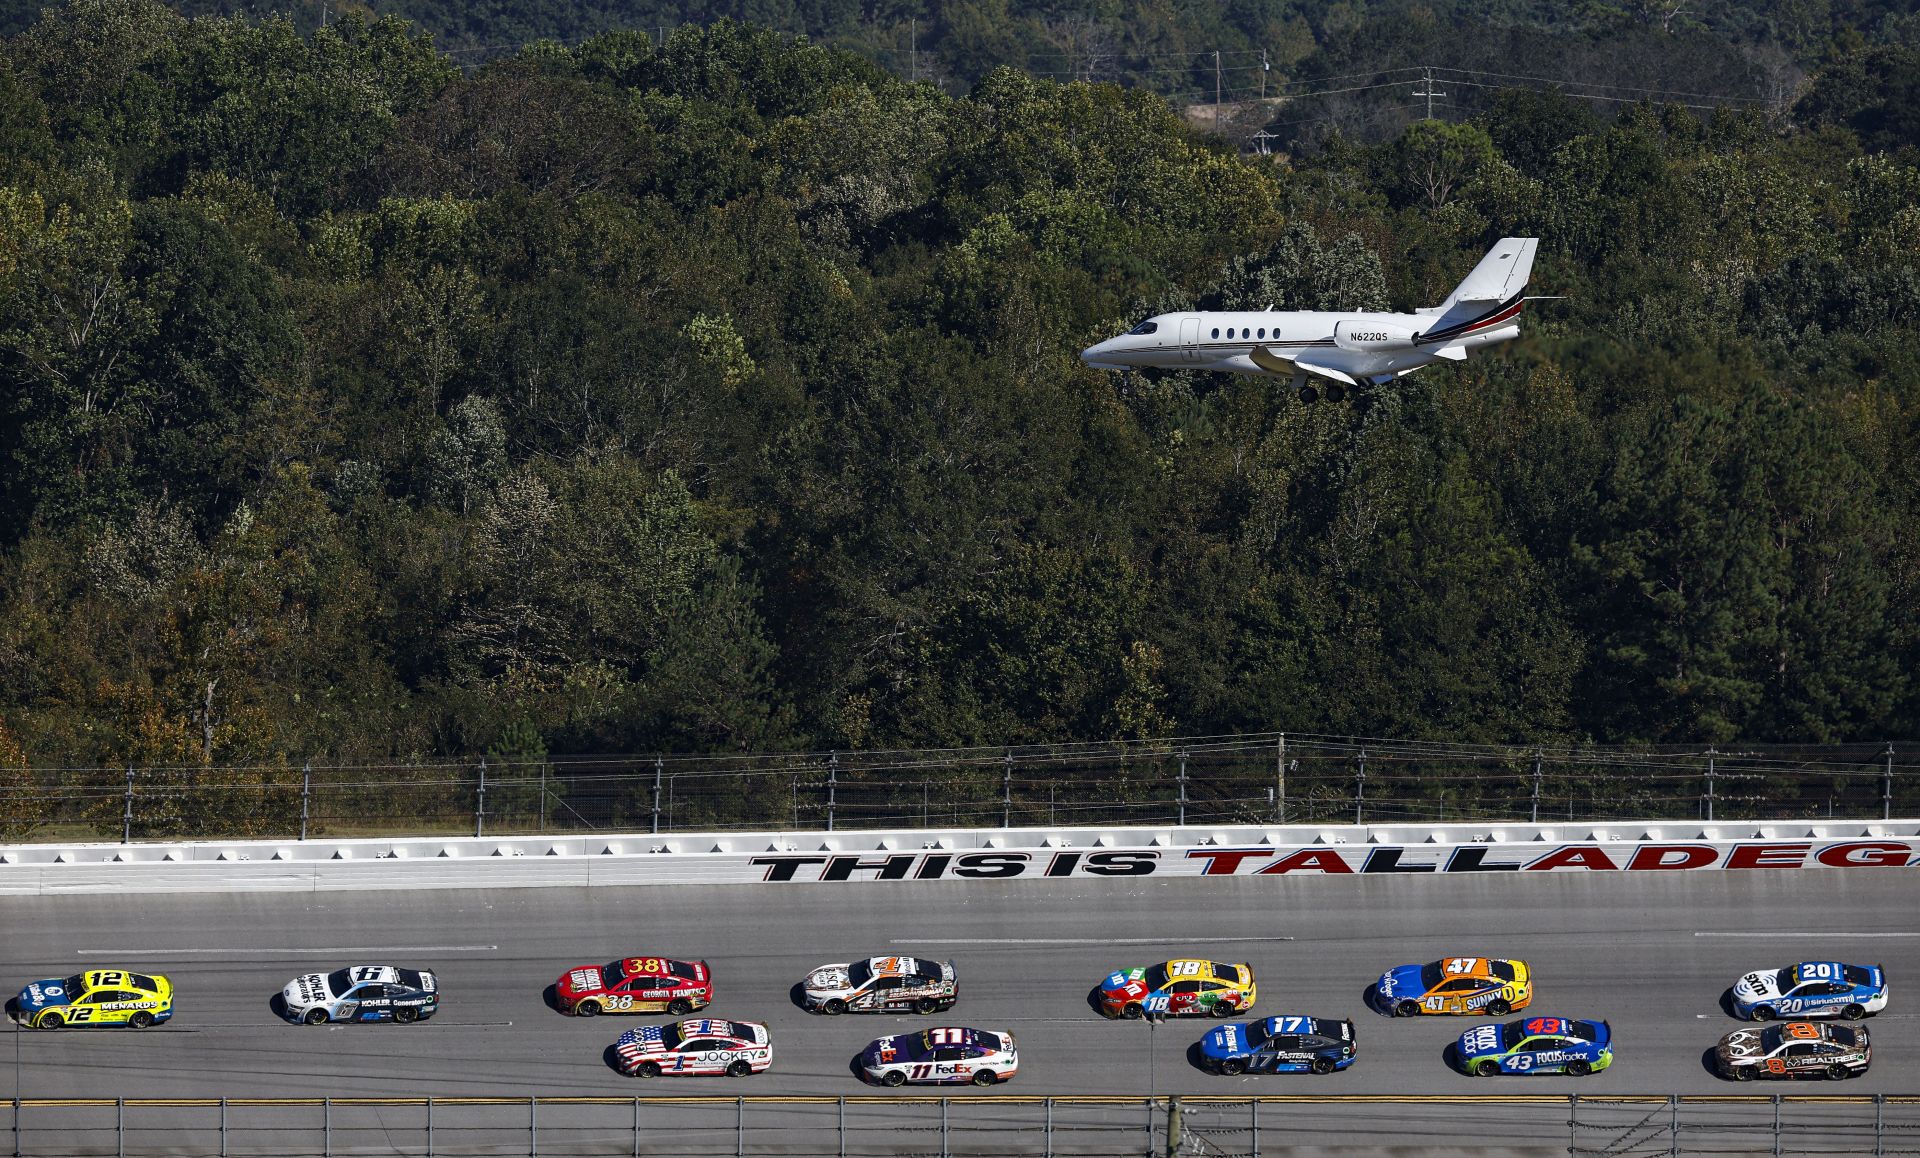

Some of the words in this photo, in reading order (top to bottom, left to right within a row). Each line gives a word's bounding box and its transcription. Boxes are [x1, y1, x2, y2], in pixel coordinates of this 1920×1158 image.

[1350, 332, 1388, 342] N622QS
[748, 851, 1032, 882] THIS
[1044, 850, 1162, 878] IS
[1185, 840, 1920, 876] TALLADEG
[628, 958, 660, 974] 38
[872, 957, 901, 974] 4
[1172, 961, 1201, 977] 18
[1446, 958, 1477, 974] 47
[1803, 963, 1831, 978] 20
[91, 971, 123, 987] 12
[355, 966, 385, 982] 6
[308, 974, 326, 1002] KOHLER
[642, 990, 670, 999] GEORGIA
[672, 988, 701, 998] PEANUTS
[101, 1001, 158, 1012] MENARDS
[361, 999, 391, 1008] KOHLER
[393, 998, 427, 1007] Generators
[605, 995, 634, 1010] 38
[855, 994, 875, 1008] 4
[1149, 996, 1169, 1011] 18
[1425, 996, 1445, 1010] 47
[1780, 999, 1802, 1013] 20
[67, 1008, 94, 1022] 12
[696, 1019, 712, 1035] 1
[1274, 1017, 1303, 1033] 17
[1527, 1018, 1561, 1034] 43
[1785, 1022, 1819, 1039] 8
[931, 1028, 964, 1044] 11
[1476, 1025, 1497, 1051] FOCUS
[697, 1050, 758, 1062] JOCKEY
[880, 1037, 897, 1064] FedEx
[1276, 1050, 1317, 1060] FASTENAL
[672, 1055, 685, 1072] 1
[1249, 1053, 1276, 1068] 17
[1506, 1055, 1533, 1070] 43
[1766, 1058, 1787, 1074] 8
[1801, 1054, 1858, 1065] REALTREE
[911, 1064, 933, 1079] 11
[935, 1063, 972, 1074] FedEx
